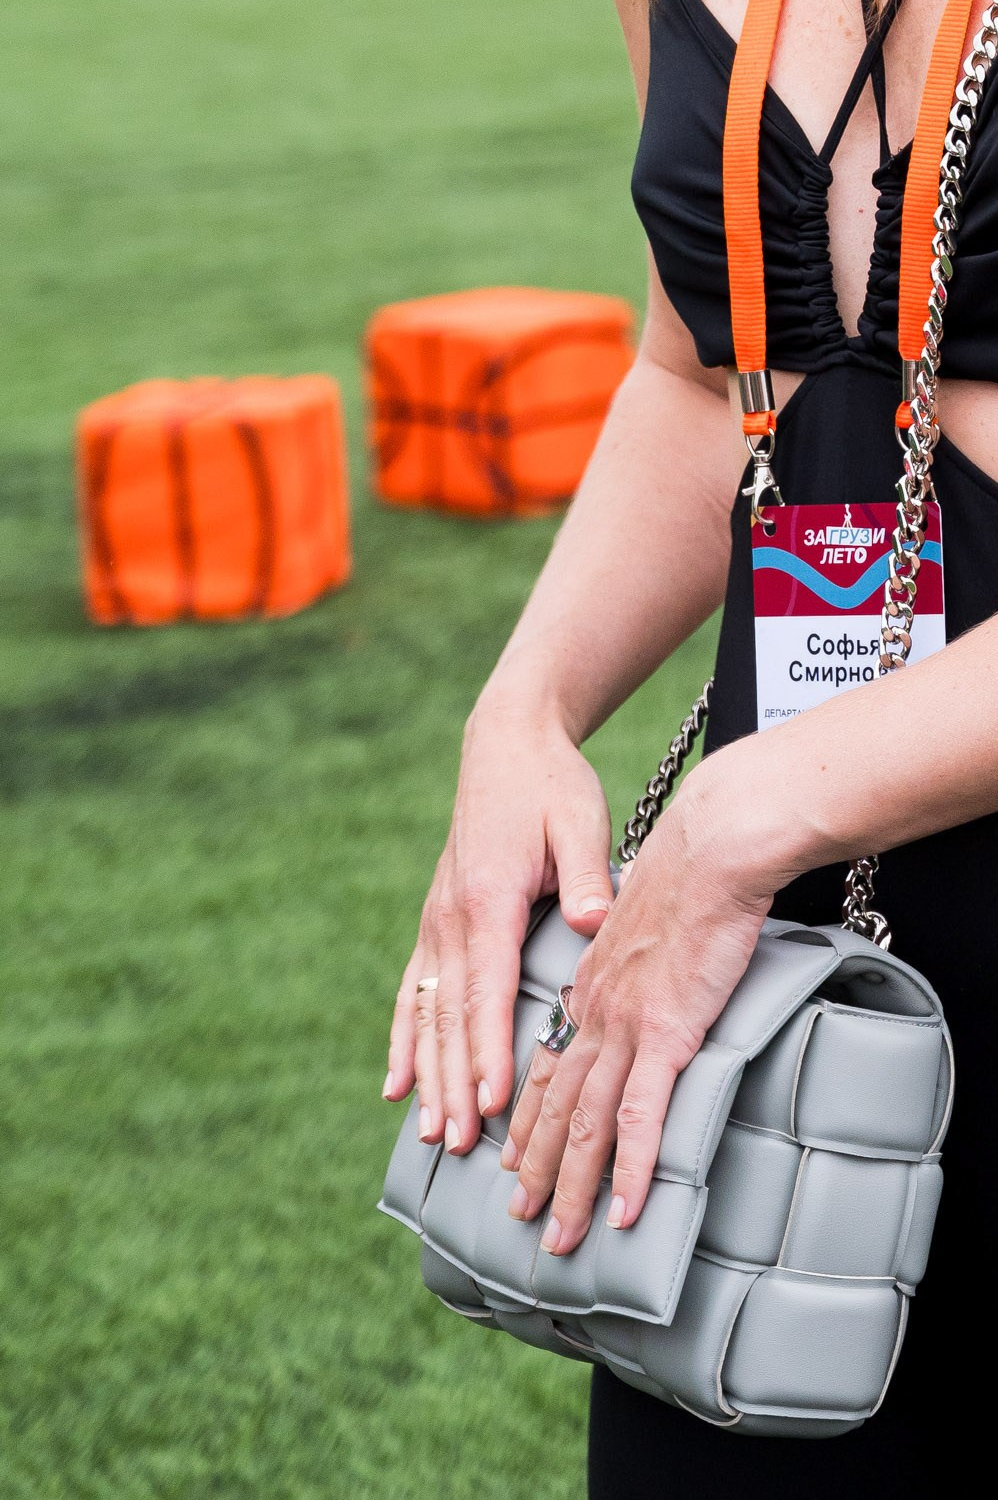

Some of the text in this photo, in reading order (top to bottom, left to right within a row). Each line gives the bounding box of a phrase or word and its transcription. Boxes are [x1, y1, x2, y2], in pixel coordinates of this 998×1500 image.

[803, 527, 886, 546] ЗАГРУЗИ
[819, 547, 867, 564] ЛЕТО
[806, 633, 881, 660] Софья
[764, 708, 805, 718] ДЕПАРТА
